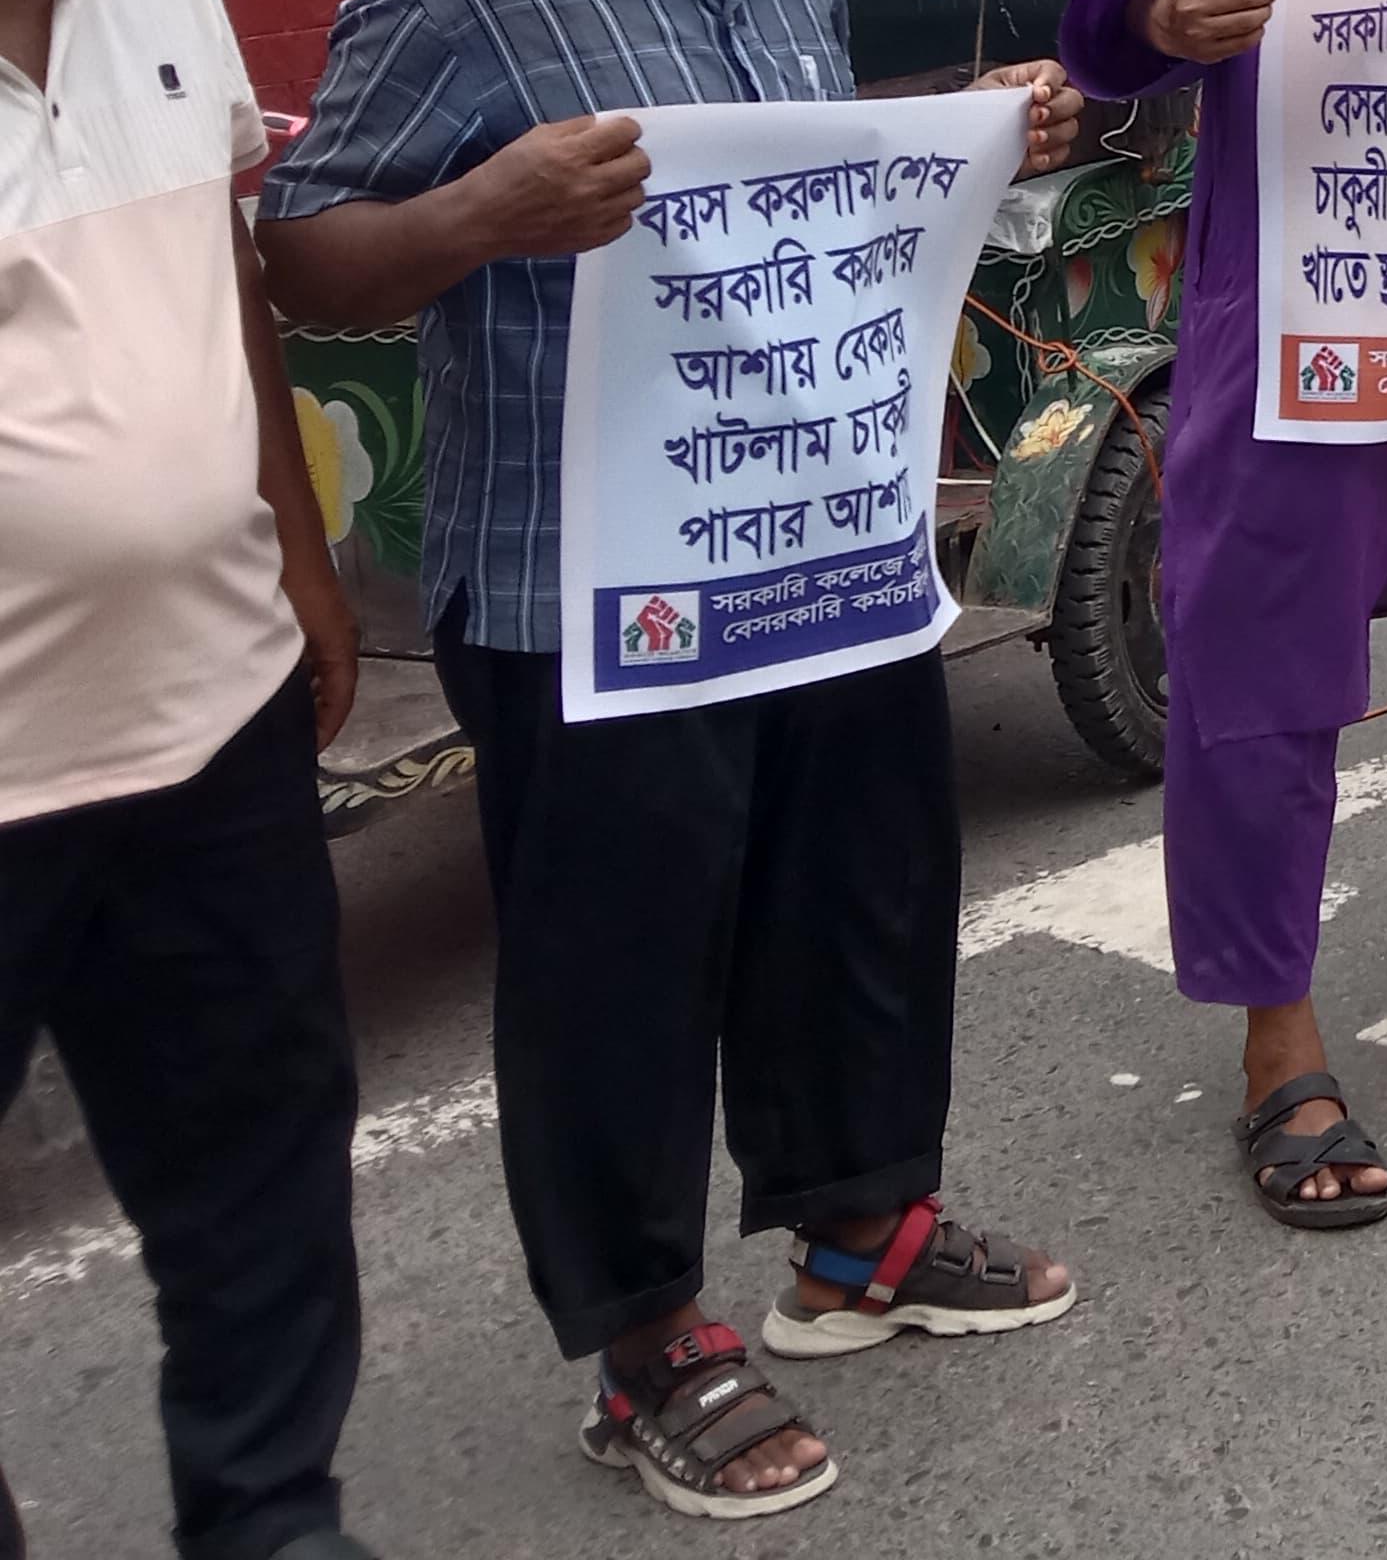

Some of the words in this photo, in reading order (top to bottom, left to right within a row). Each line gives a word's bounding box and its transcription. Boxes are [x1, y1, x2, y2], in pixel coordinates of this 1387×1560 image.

[637, 183, 733, 247] বয়স
[740, 159, 879, 227] করলাম
[885, 152, 969, 200] শেষ
[650, 237, 816, 321] সরকারি
[1301, 242, 1371, 305] খাতে
[671, 337, 820, 400] আশায়
[835, 307, 906, 381] বেকার
[664, 411, 837, 485] খাটলাম
[678, 500, 813, 565] পাবার
[711, 572, 809, 614] সরকারি
[814, 553, 906, 589] কলেজে
[723, 597, 844, 644] বেসরকারি
